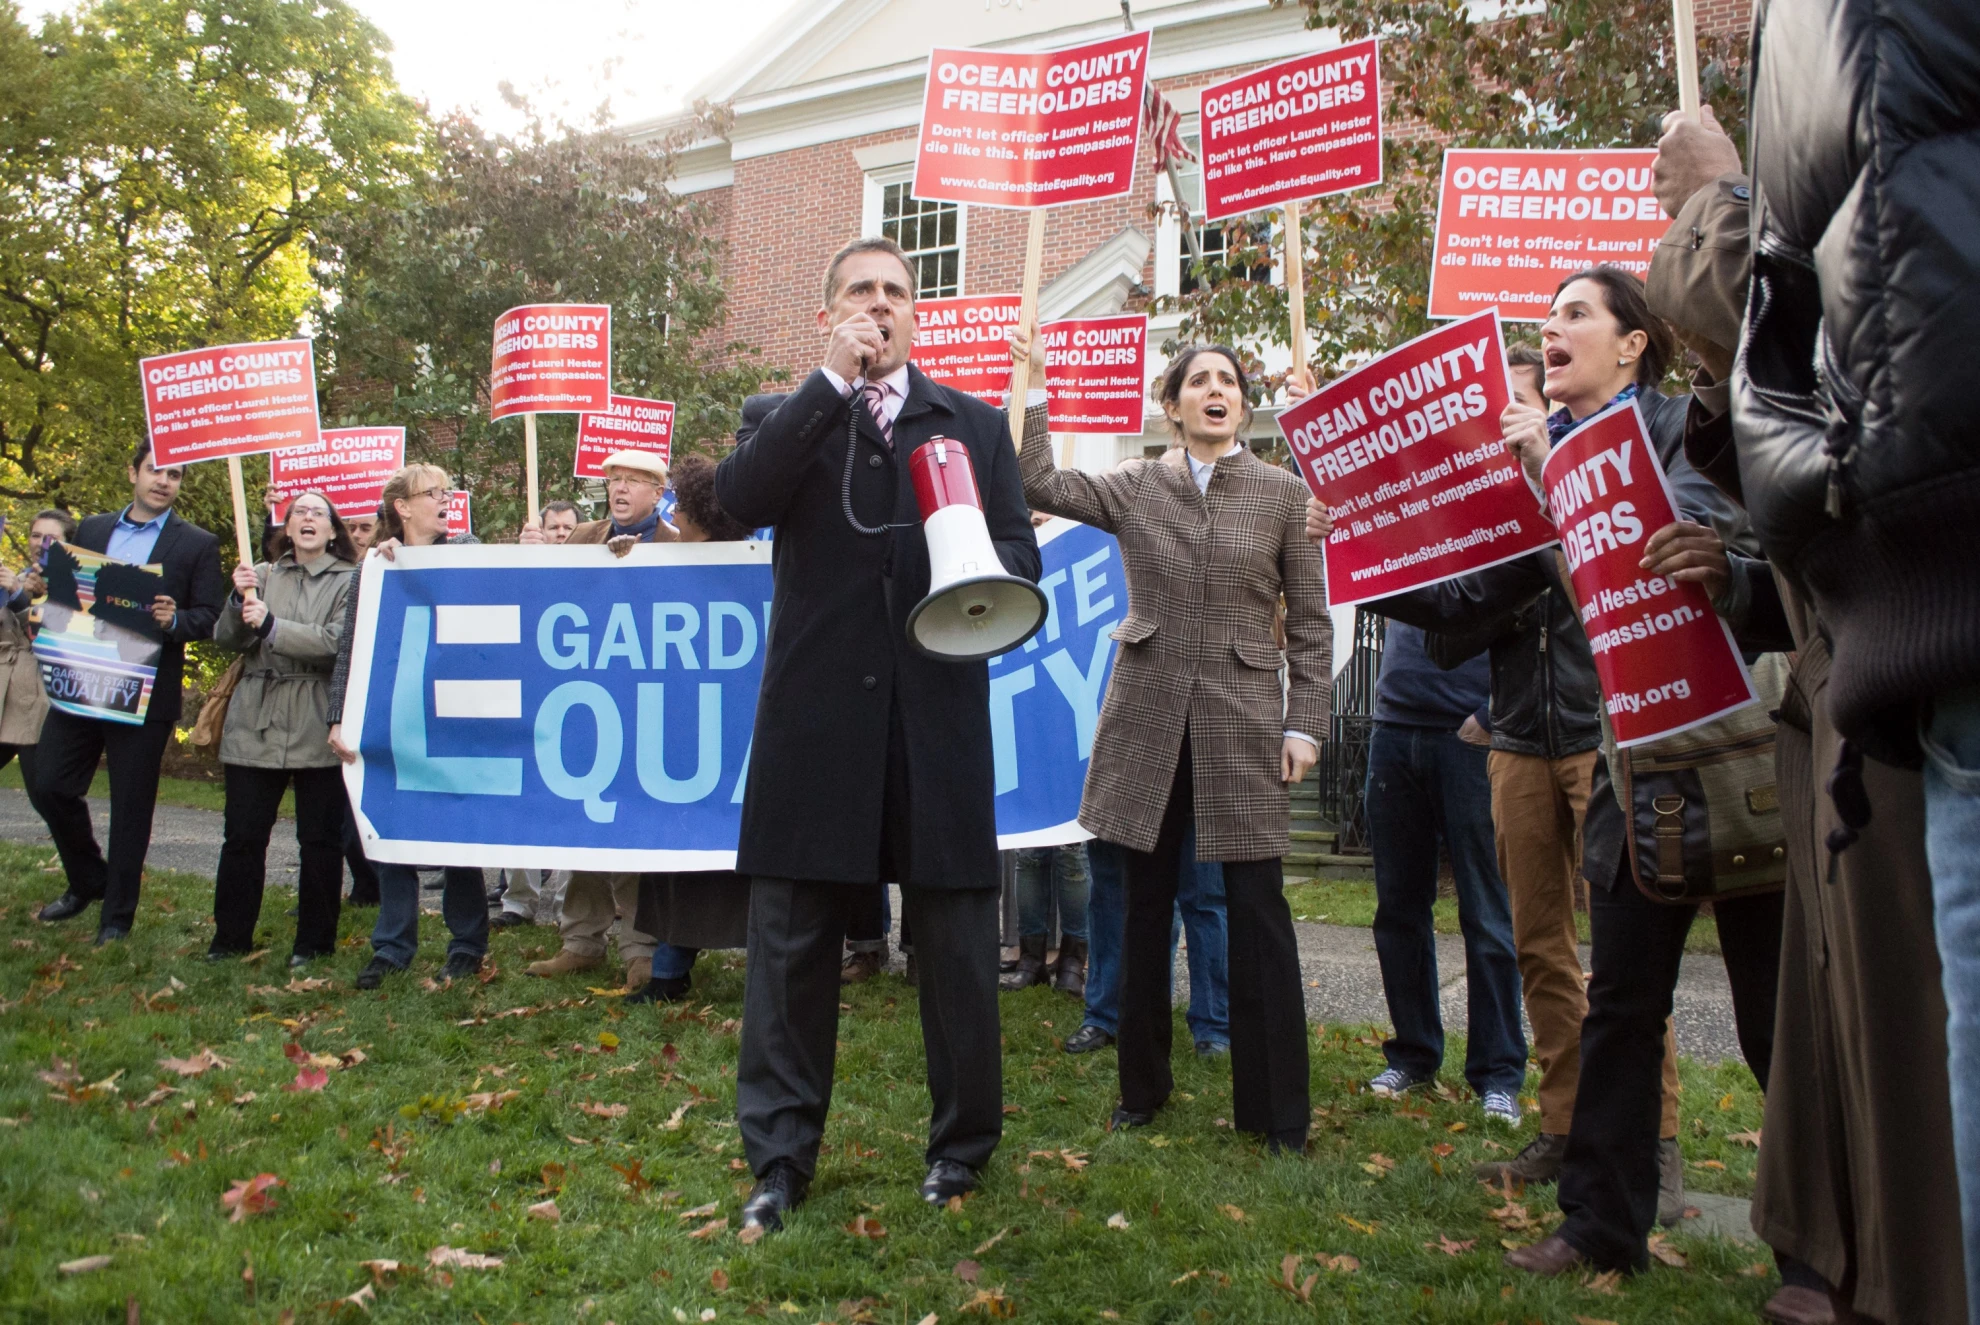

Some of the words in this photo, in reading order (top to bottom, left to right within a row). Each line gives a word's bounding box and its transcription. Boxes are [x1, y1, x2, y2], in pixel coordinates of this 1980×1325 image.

[938, 63, 1038, 89] OCEAN
[1046, 46, 1144, 87] COUNTY
[942, 77, 1132, 115] FREEHOLDERS
[1205, 80, 1271, 118] OCEAN
[1276, 53, 1371, 96] COUNTY
[1210, 81, 1366, 140] FREEHOLDERS
[931, 123, 972, 138] Don't
[976, 125, 997, 141] let
[1001, 129, 1049, 143] officer
[1052, 126, 1089, 142] Laurel
[1092, 114, 1133, 132] Hester
[1208, 149, 1235, 165] Don't
[1237, 144, 1251, 158] let
[1253, 134, 1287, 153] officer
[1290, 125, 1327, 143] Laurel
[1330, 114, 1372, 132] Hester
[925, 140, 949, 154] die
[953, 142, 981, 157] like
[985, 144, 1018, 160] this.
[1023, 147, 1056, 161] Have
[1058, 133, 1133, 158] compassion.
[1207, 165, 1222, 180] die
[1224, 161, 1242, 176] like
[1244, 156, 1267, 172] this.
[1269, 148, 1297, 164] Have
[1300, 131, 1376, 157] compassion.
[940, 171, 1115, 193] www.GardenStateEquality.org
[1220, 165, 1362, 205] www.GardenStateEquality.org
[1453, 166, 1567, 191] OCEAN
[1577, 167, 1653, 192] COU
[1458, 194, 1668, 221] FREEHOLDE
[1447, 233, 1493, 248] Don't
[1497, 234, 1520, 249] let
[1524, 235, 1583, 250] officer
[1587, 237, 1643, 252] Laurel
[1440, 252, 1467, 266] die
[1471, 253, 1502, 267] like
[1507, 254, 1544, 269] this.
[1550, 256, 1593, 270] Have
[523, 315, 605, 332] COUNTY
[918, 309, 957, 327] EAN
[964, 306, 1022, 324] COUN
[912, 325, 1015, 347] EEHOLDE
[1040, 330, 1067, 348] EAN
[1072, 326, 1143, 347] COUNTY
[148, 359, 214, 385] OCEAN
[219, 350, 306, 373] COUNTY
[532, 358, 564, 369] Laurel
[567, 358, 603, 368] Hester
[921, 357, 936, 367] let
[938, 354, 974, 366] officer
[977, 352, 1008, 363] Laurel
[1045, 347, 1137, 366] EHOLDERS
[516, 372, 537, 382] Have
[539, 370, 605, 381] compassion.
[929, 369, 953, 378] this.
[956, 367, 983, 376] Have
[1045, 376, 1076, 387] officer
[1078, 376, 1108, 387] Laurel
[1110, 376, 1140, 386] Hester
[156, 368, 302, 402] FREEHOLDERS
[1058, 389, 1082, 399] Have
[1084, 389, 1141, 400] compassion.
[1292, 396, 1367, 456] OCEAN
[1369, 336, 1490, 417] COUNTY
[154, 408, 181, 423] Don't
[182, 407, 197, 419] let
[198, 401, 233, 415] officer
[235, 395, 270, 410] Laurel
[271, 393, 309, 406] Hester
[609, 403, 632, 418] EAN
[634, 406, 672, 422] COUNTY
[154, 422, 170, 435] die
[171, 420, 189, 432] like
[191, 417, 214, 429] this.
[215, 413, 243, 424] Have
[244, 406, 313, 423] compassion.
[588, 415, 668, 436] FREEHOLDERS
[169, 429, 302, 455] www.GardenStateEquality.org
[331, 435, 400, 451] COUNTY
[583, 435, 603, 444] Don't
[603, 437, 613, 445] let
[614, 438, 636, 448] officer
[1310, 383, 1488, 486] FREEHOLDERS
[280, 449, 394, 472] FREEHOLDERS
[580, 444, 591, 452] die
[593, 445, 606, 453] like
[300, 477, 312, 486] let
[312, 475, 339, 484] officer
[341, 471, 367, 481] Laurel
[326, 484, 347, 493] Have
[1328, 498, 1356, 522] Don't
[1357, 492, 1372, 511] let
[1374, 477, 1412, 504] officer
[1412, 462, 1453, 490] Laurel
[1455, 437, 1507, 470] Hester
[1329, 525, 1350, 544] die
[1350, 517, 1373, 539] like
[1373, 510, 1400, 533] this.
[1399, 500, 1430, 519] Have
[1431, 464, 1519, 508] compassion.
[1350, 518, 1522, 583] www.GardenStateEquality.org
[536, 600, 772, 671] GARD
[52, 667, 100, 683] GARDEN
[103, 675, 140, 691] STATE
